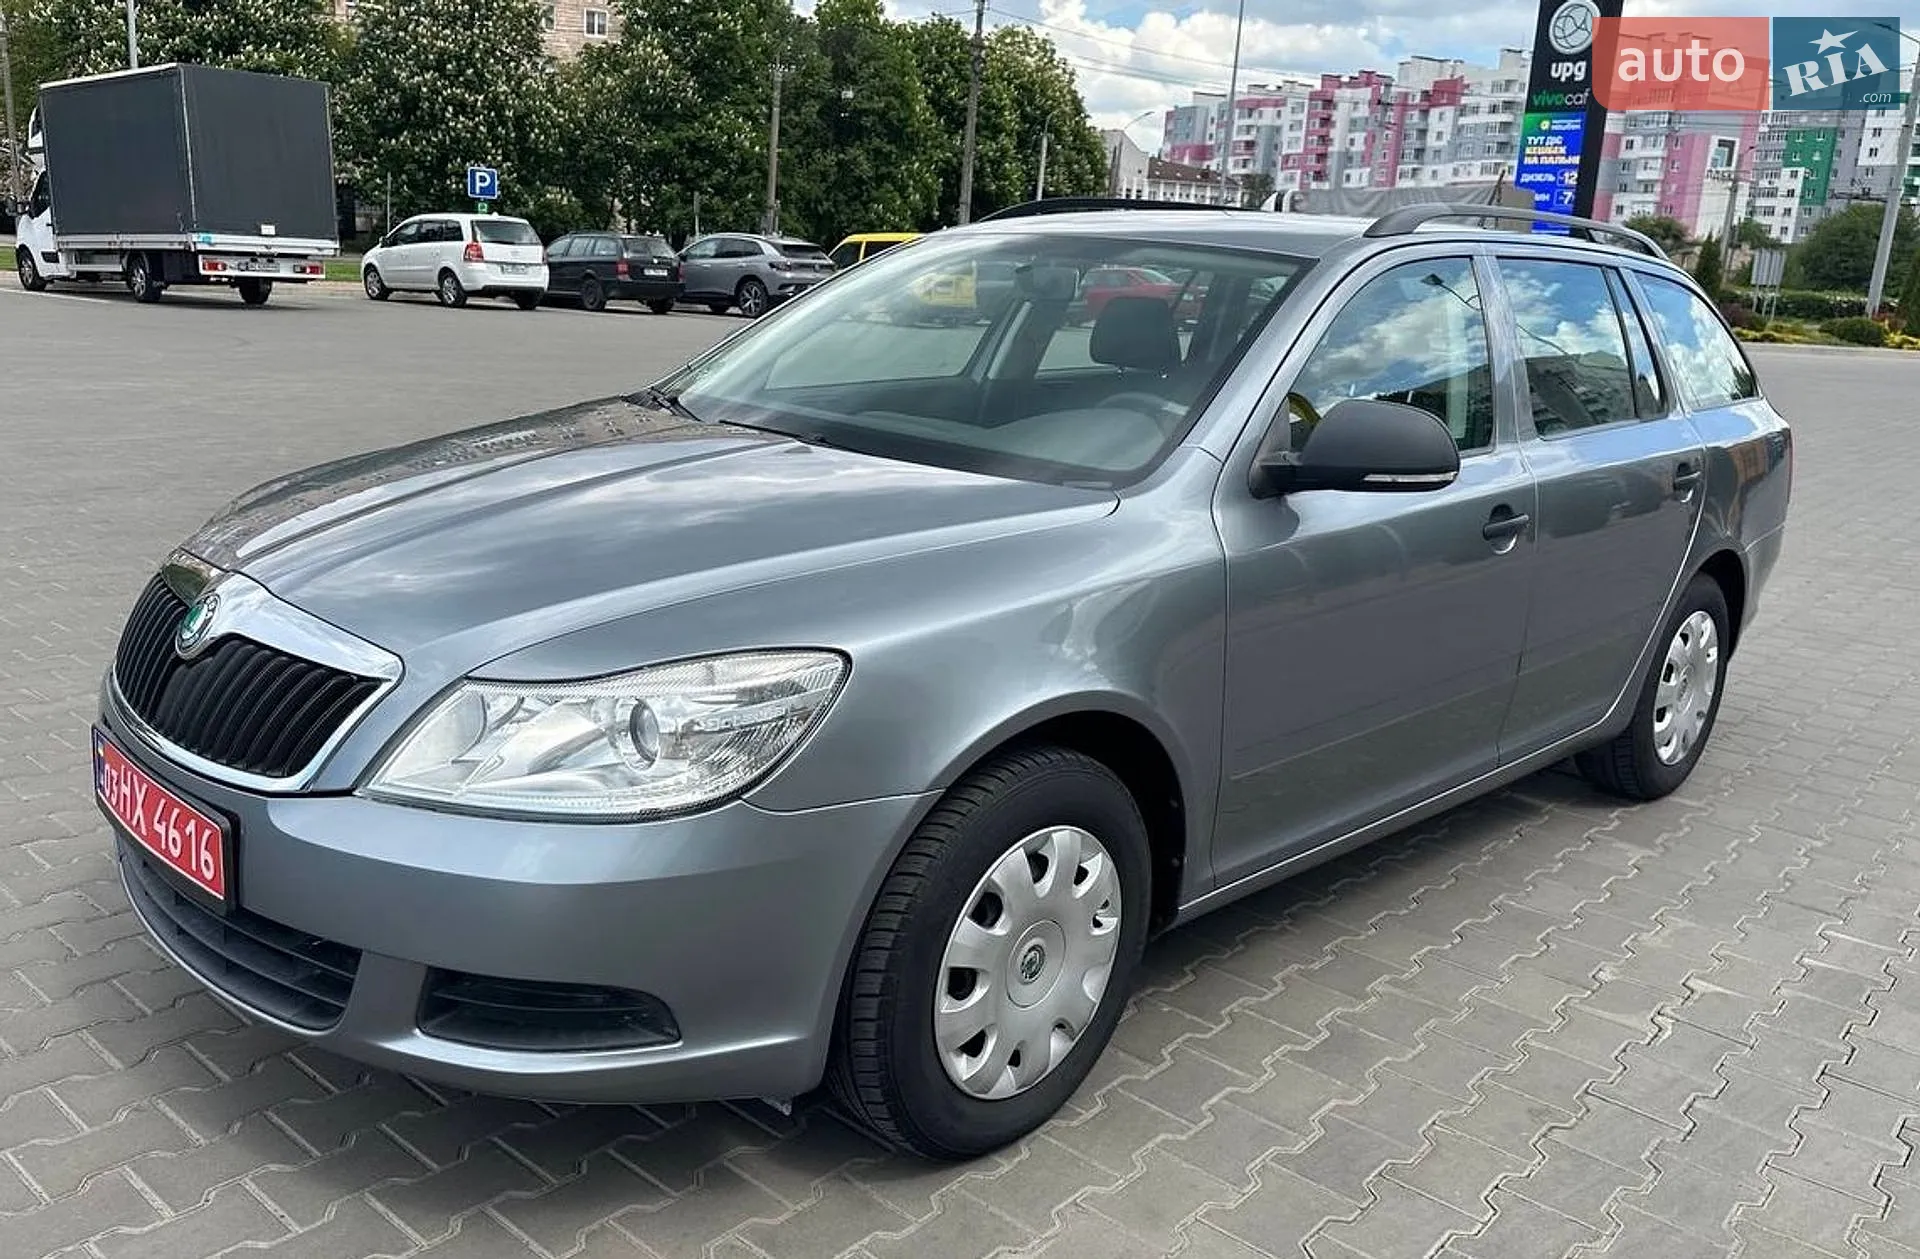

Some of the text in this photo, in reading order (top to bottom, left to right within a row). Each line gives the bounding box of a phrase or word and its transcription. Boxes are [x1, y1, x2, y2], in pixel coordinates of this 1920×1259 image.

[1551, 60, 1587, 82] upg
[475, 171, 491, 195] P
[153, 798, 215, 882] 4616
